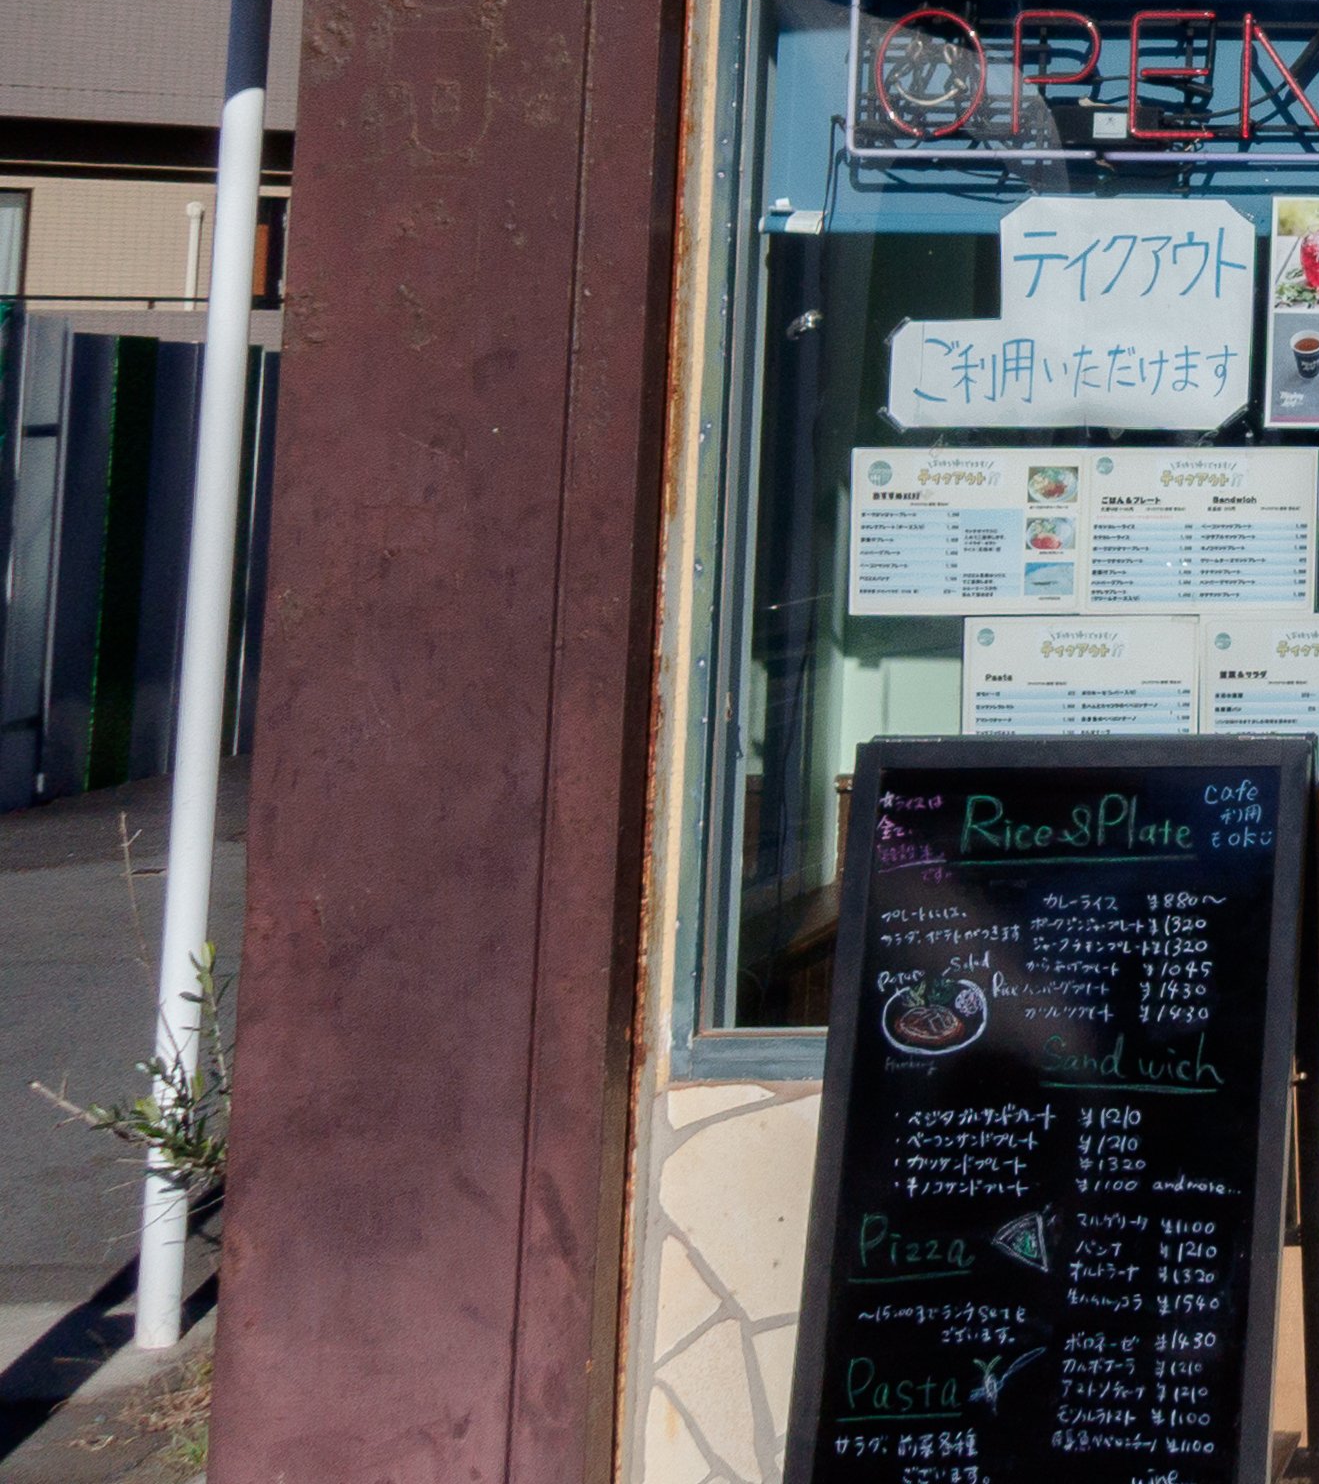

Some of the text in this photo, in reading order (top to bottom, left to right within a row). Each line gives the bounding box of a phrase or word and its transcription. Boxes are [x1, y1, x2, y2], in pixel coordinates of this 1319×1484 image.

[1012, 225, 1248, 302] テイクアウト
[912, 336, 1239, 406] ご利用いただけます
[1220, 803, 1262, 825] 利用
[1043, 892, 1119, 911] カレーライス
[1148, 914, 1207, 936] ¥1320
[1151, 937, 1208, 957] ¥1320
[1142, 961, 1213, 979] ¥1045
[1139, 979, 1207, 1001] ¥1430
[1139, 1004, 1209, 1023] ¥1430
[1079, 1105, 1142, 1130] ¥1210
[906, 1130, 1139, 1155] ベーコンサンドプレート ¥1210
[1078, 1156, 1147, 1171] ¥1320
[1075, 1177, 1139, 1193] ¥1100
[1076, 1212, 1216, 1235] マルゲリータ ¥1100
[860, 1213, 975, 1269] Pizza
[1159, 1241, 1217, 1263] ¥1210
[1069, 1260, 1215, 1285] オルトラーナ ¥1320
[1156, 1293, 1220, 1317] ¥1540
[1063, 1329, 1217, 1353] ボロネーゼ ¥1430
[848, 1356, 962, 1412] Pasta
[1156, 1384, 1209, 1405] ¥1210
[1151, 1408, 1211, 1428] ¥1100
[1165, 1435, 1215, 1454] ¥1100
